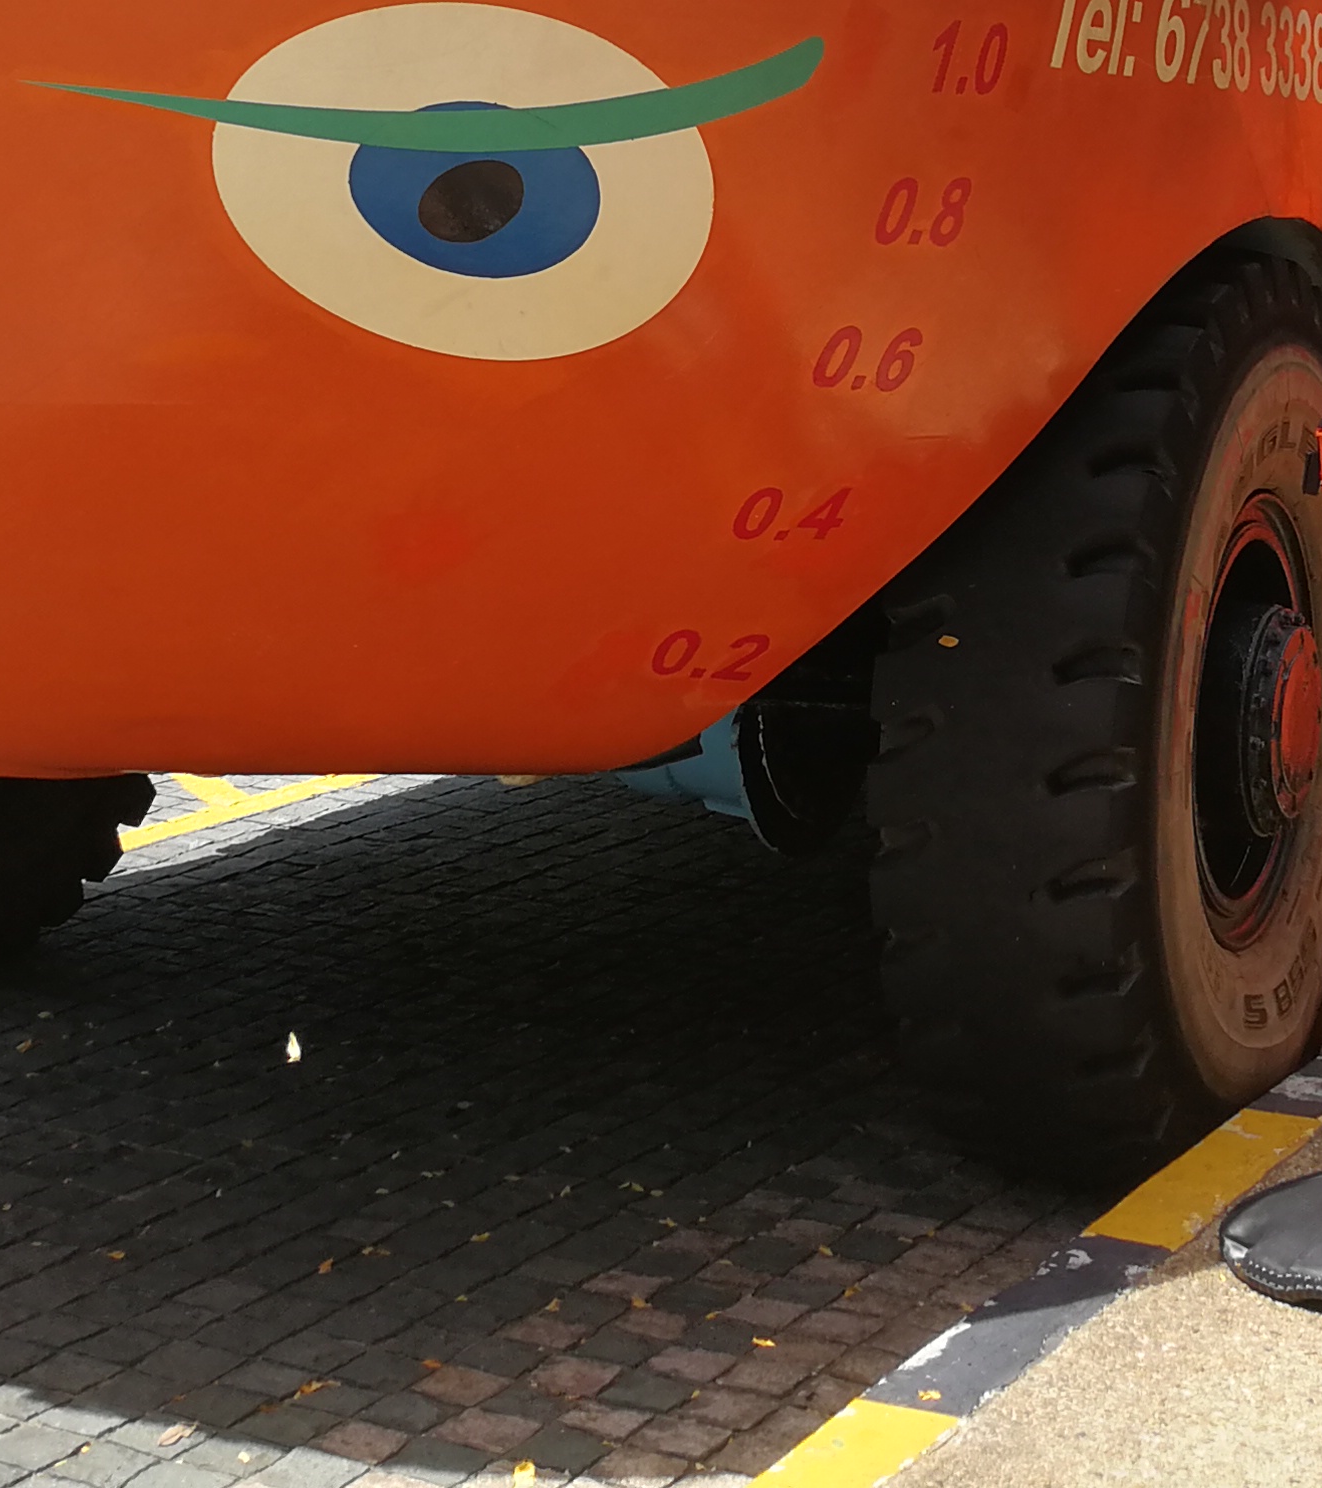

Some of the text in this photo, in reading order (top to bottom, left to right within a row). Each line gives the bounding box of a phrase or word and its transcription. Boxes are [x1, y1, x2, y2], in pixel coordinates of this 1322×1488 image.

[931, 18, 1009, 96] 1.0
[875, 176, 973, 248] 0.8
[811, 324, 924, 392] 0.6
[732, 486, 854, 541] 0.4
[650, 628, 771, 682] 0.2
